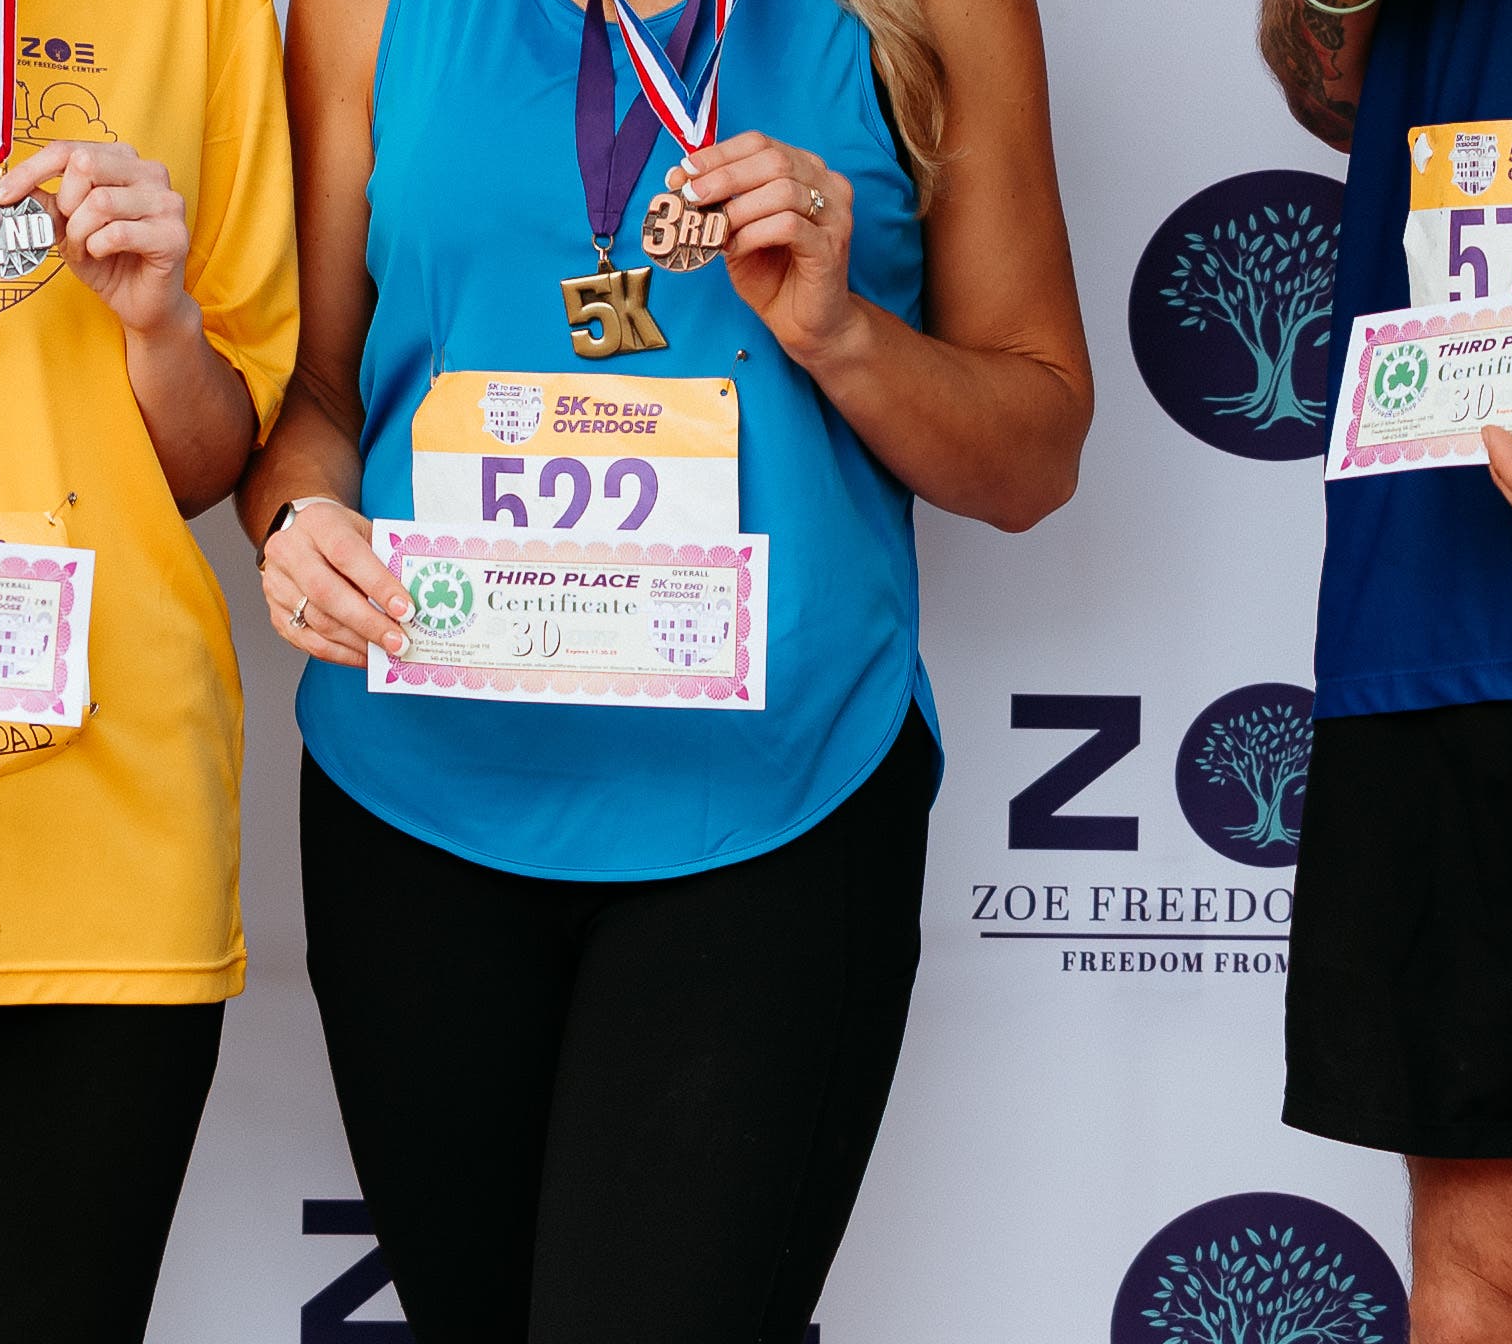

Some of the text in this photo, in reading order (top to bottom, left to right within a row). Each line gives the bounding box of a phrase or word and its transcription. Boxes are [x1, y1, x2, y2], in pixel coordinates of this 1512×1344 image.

[642, 192, 728, 257] 3RD
[559, 265, 669, 361] 5K
[1437, 337, 1497, 359] THIRD
[553, 396, 663, 418] 5K TO END
[552, 419, 658, 435] OVERDOSE
[483, 569, 641, 589] THIRD PLACE
[671, 569, 710, 578] OVERALL
[487, 588, 638, 616] Certificate
[1008, 682, 1316, 868] ZO
[970, 883, 1294, 925] ZOE FREEDO
[1061, 949, 1205, 974] FREEDOM
